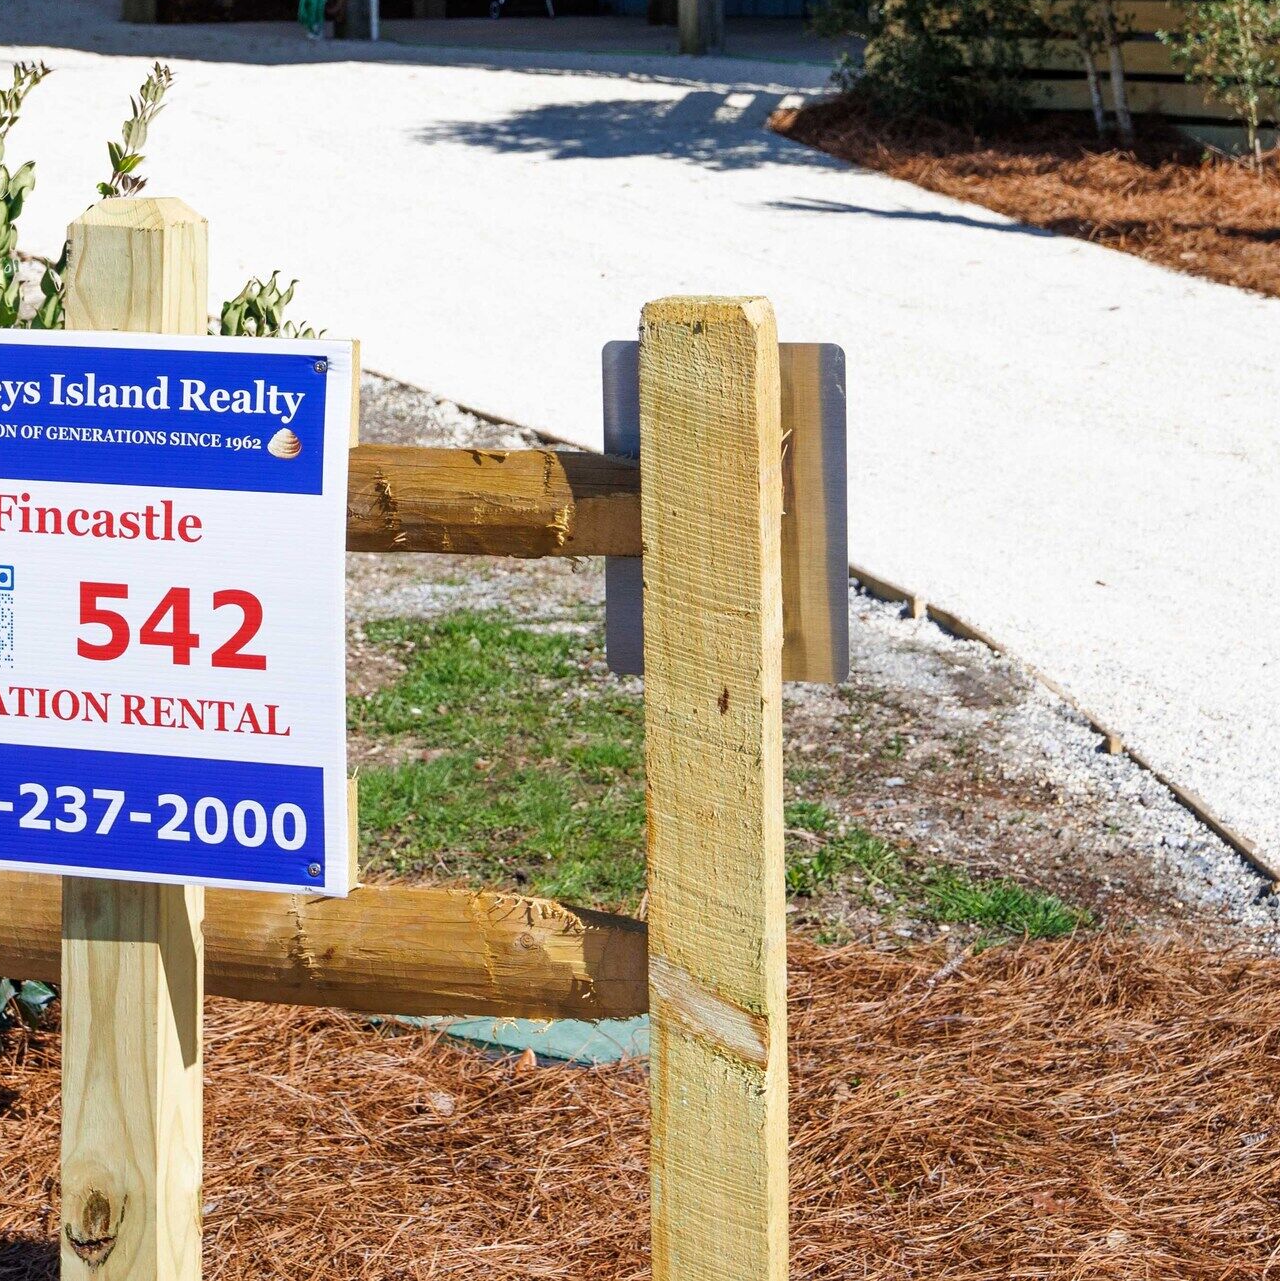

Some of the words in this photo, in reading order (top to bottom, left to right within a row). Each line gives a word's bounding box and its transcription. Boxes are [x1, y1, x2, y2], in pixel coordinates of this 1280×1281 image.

[49, 372, 171, 410] Island
[178, 379, 306, 424] Realty
[20, 425, 44, 439] OF
[45, 426, 167, 445] GENERATIONS
[169, 431, 222, 449] SINCE
[225, 436, 262, 452] 1962
[76, 580, 267, 671] 542
[120, 693, 292, 738] RENTAL
